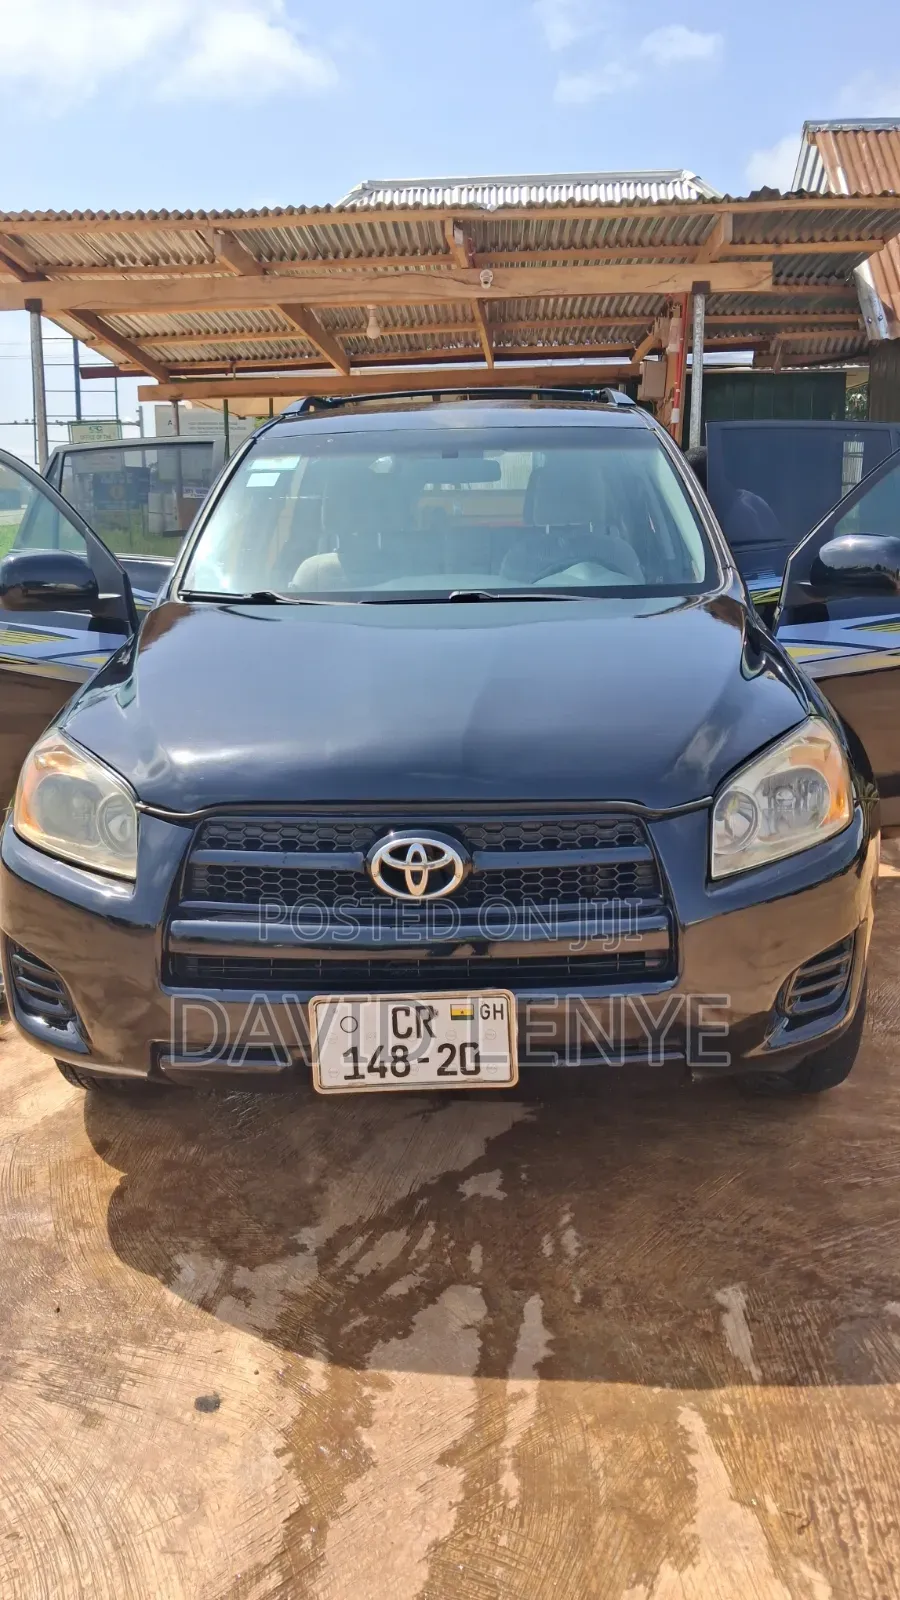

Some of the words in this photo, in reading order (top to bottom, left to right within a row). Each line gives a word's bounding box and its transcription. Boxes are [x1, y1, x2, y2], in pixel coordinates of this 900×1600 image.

[392, 1005, 437, 1039] CR
[480, 1003, 504, 1021] GH
[342, 1042, 481, 1080] 148-20
